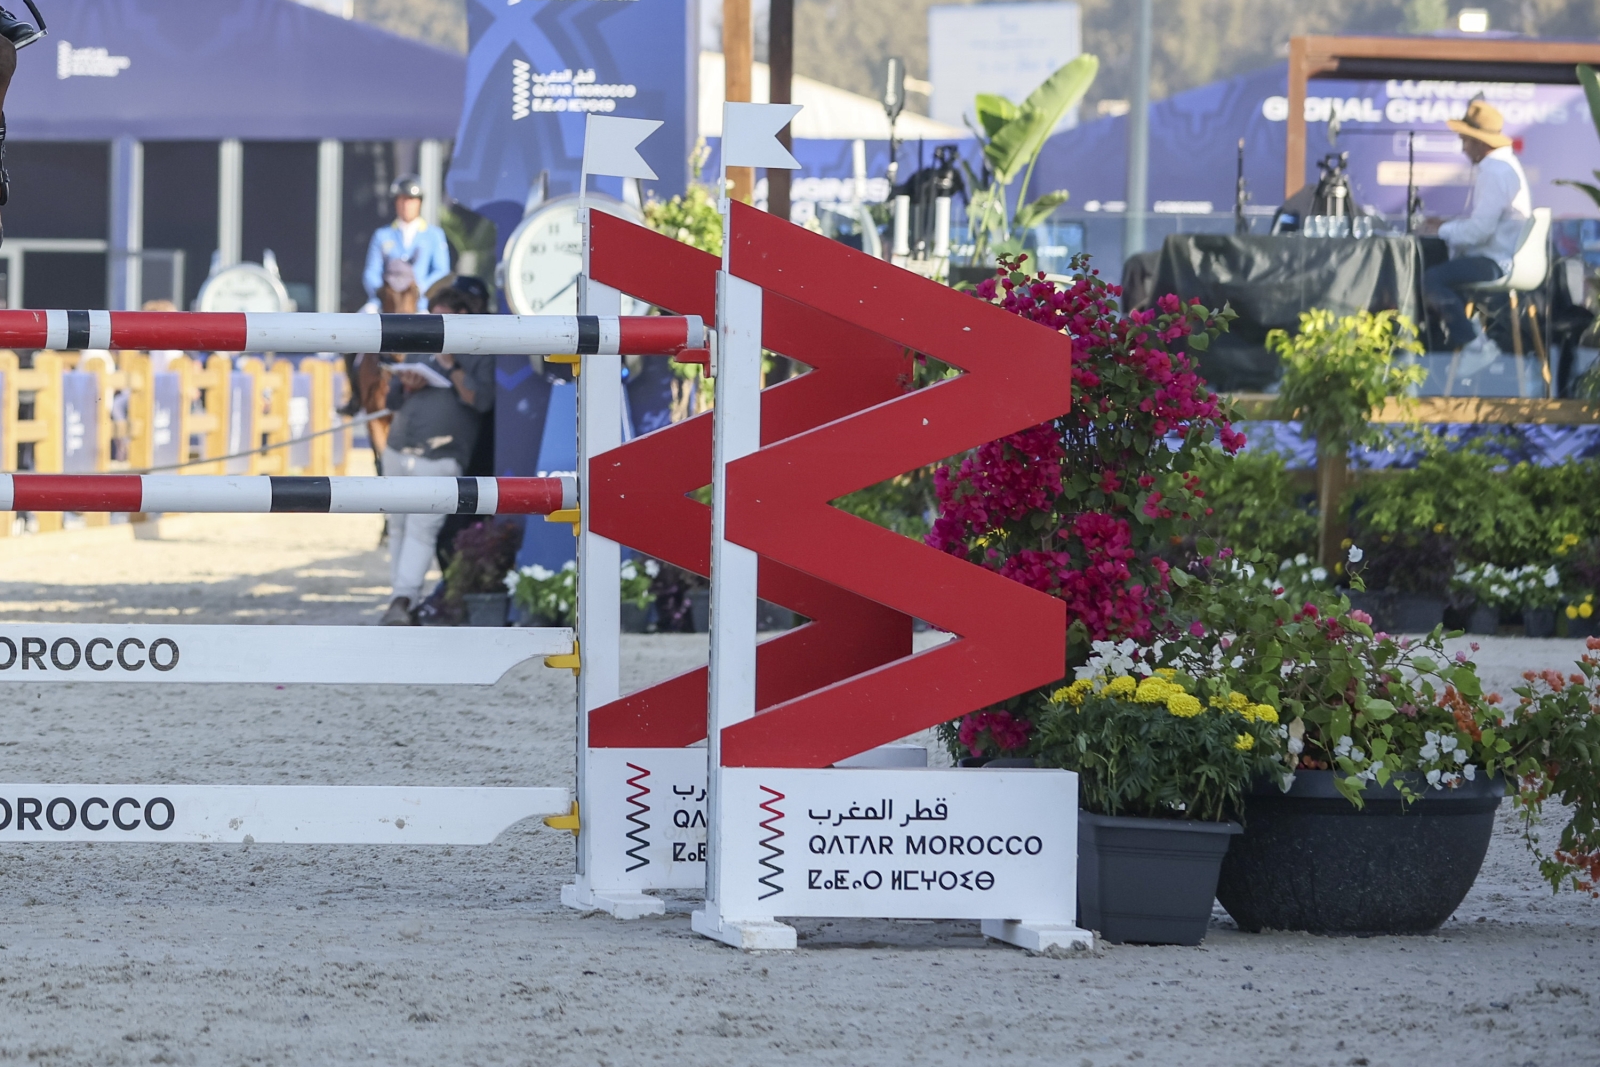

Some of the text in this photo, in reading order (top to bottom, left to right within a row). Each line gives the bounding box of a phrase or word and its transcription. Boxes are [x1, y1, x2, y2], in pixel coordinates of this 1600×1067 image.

[808, 798, 947, 826] قطر المغرب
[809, 835, 1042, 855] QATAR MOROCCO
